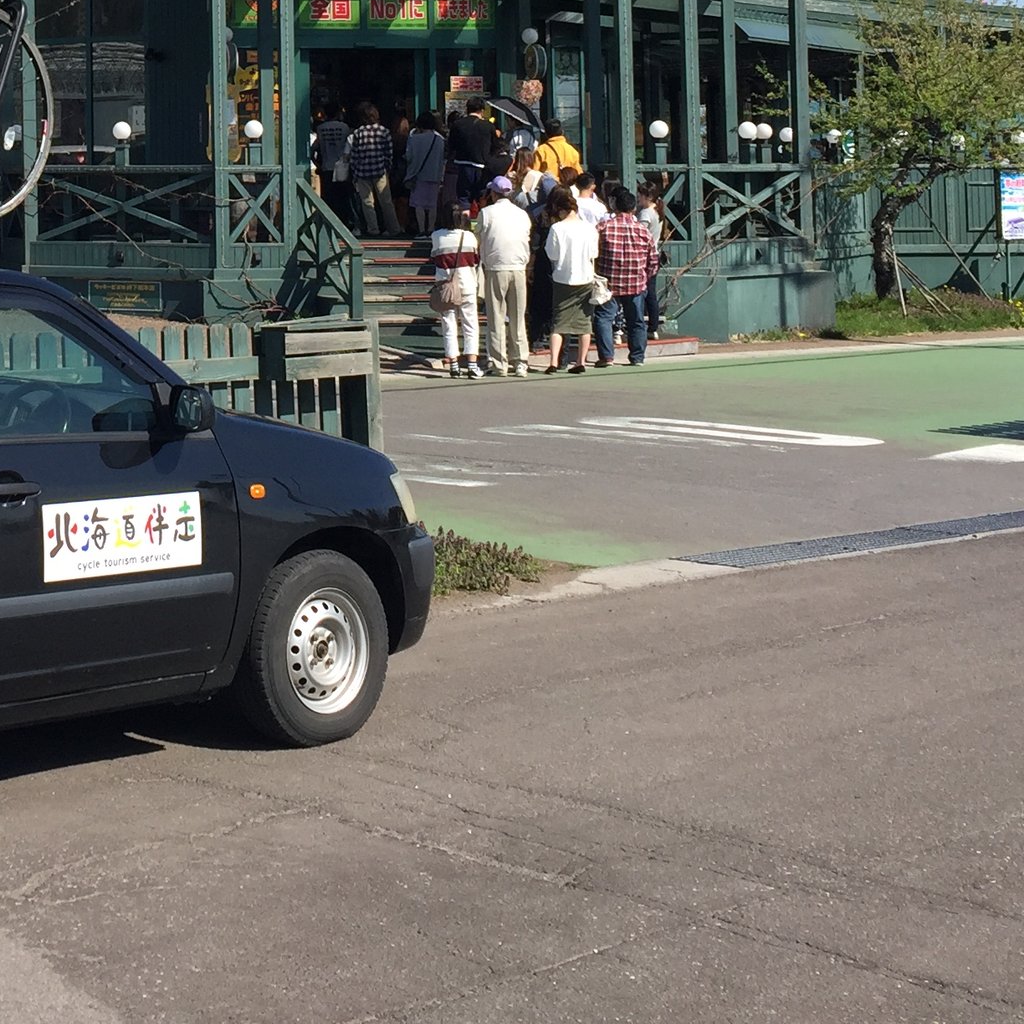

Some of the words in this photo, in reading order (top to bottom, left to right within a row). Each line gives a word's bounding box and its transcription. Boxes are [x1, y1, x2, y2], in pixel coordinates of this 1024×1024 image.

[77, 558, 100, 572] cycle
[104, 555, 138, 568] tourism
[140, 552, 171, 563] service
